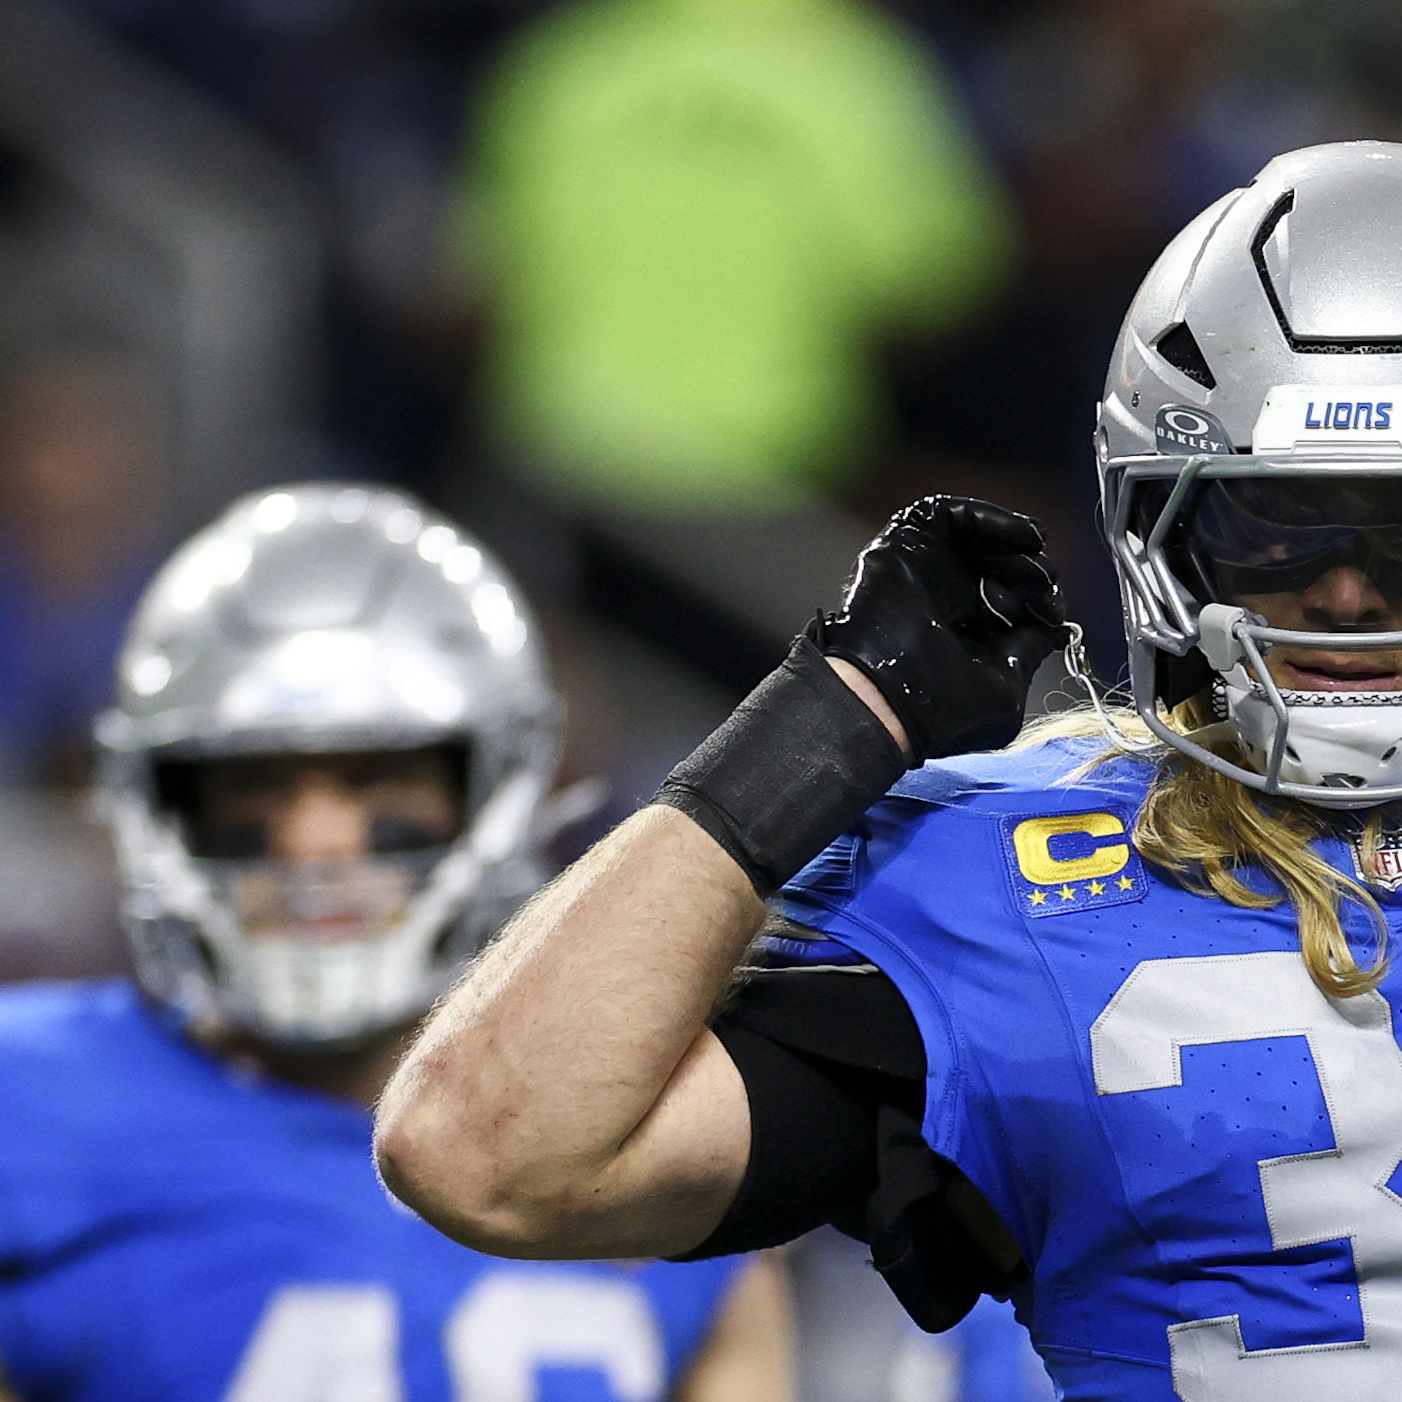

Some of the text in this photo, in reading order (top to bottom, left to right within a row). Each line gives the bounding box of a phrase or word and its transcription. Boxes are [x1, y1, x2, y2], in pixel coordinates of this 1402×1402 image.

[1304, 402, 1393, 429] LIONS
[1156, 426, 1220, 452] OAKLEY
[1012, 812, 1130, 886] C
